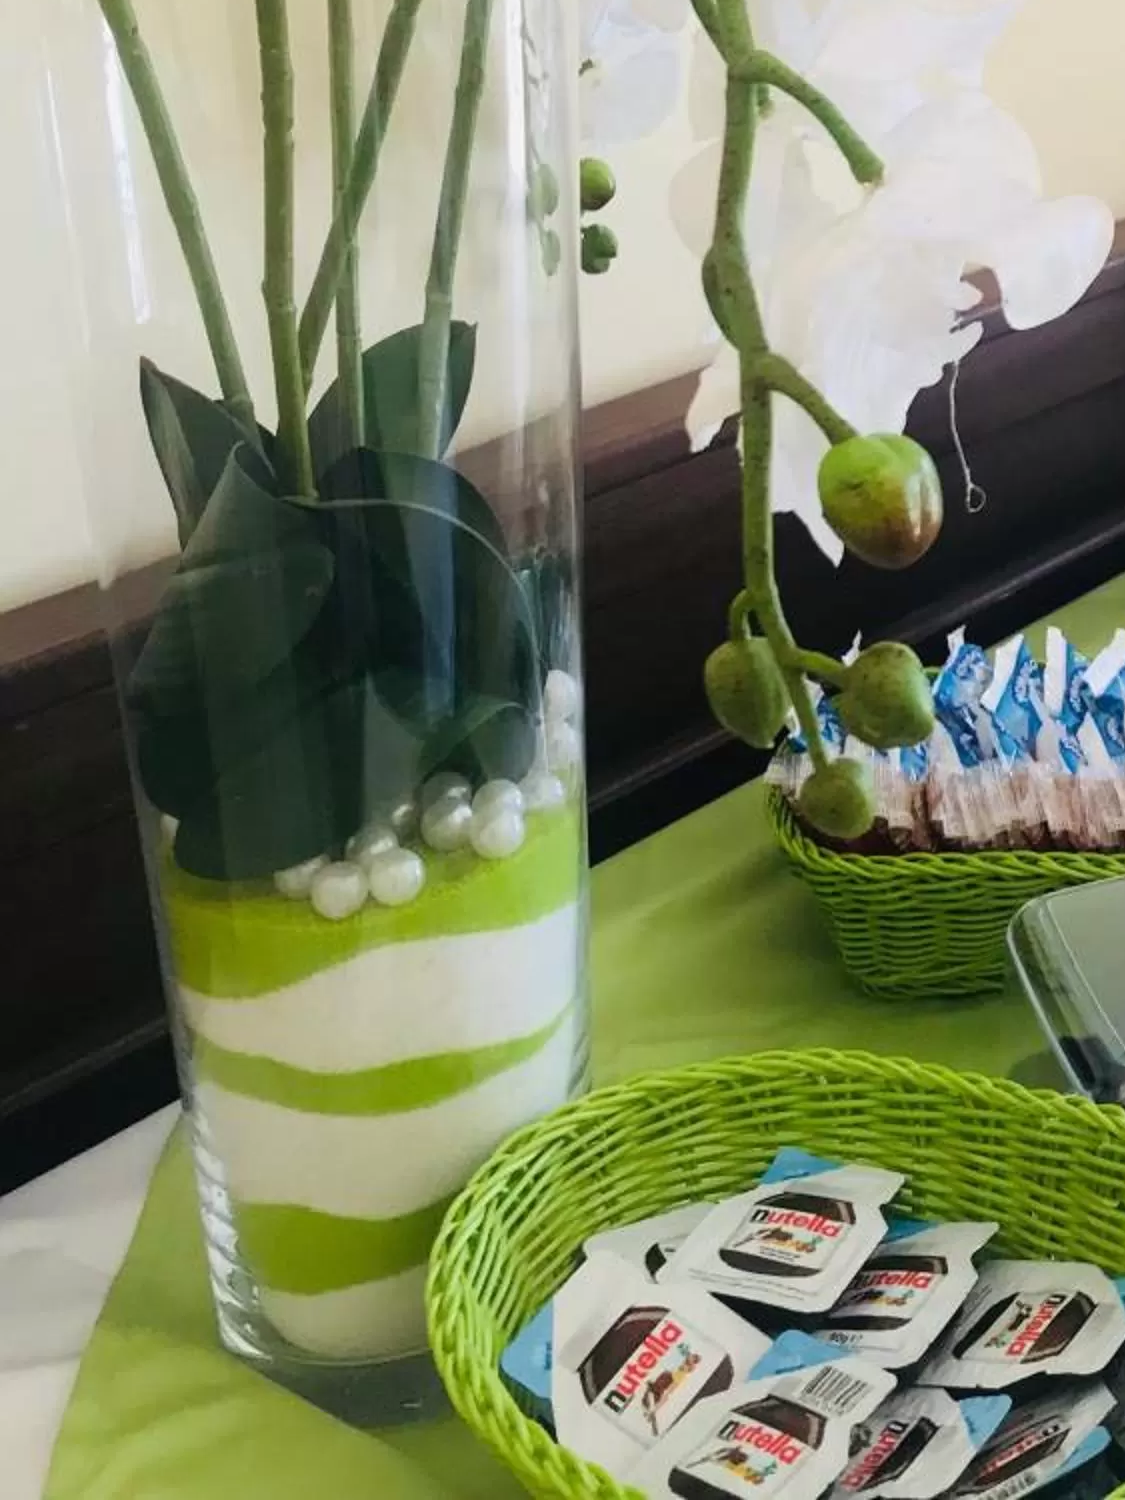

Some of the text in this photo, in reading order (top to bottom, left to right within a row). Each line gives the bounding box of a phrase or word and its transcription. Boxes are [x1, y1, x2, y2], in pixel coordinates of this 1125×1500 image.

[751, 1208, 841, 1238] nutella
[1005, 1294, 1069, 1356] nutella
[604, 1320, 684, 1413] nutella
[717, 1420, 801, 1465] nutella
[839, 1419, 911, 1491] nutella
